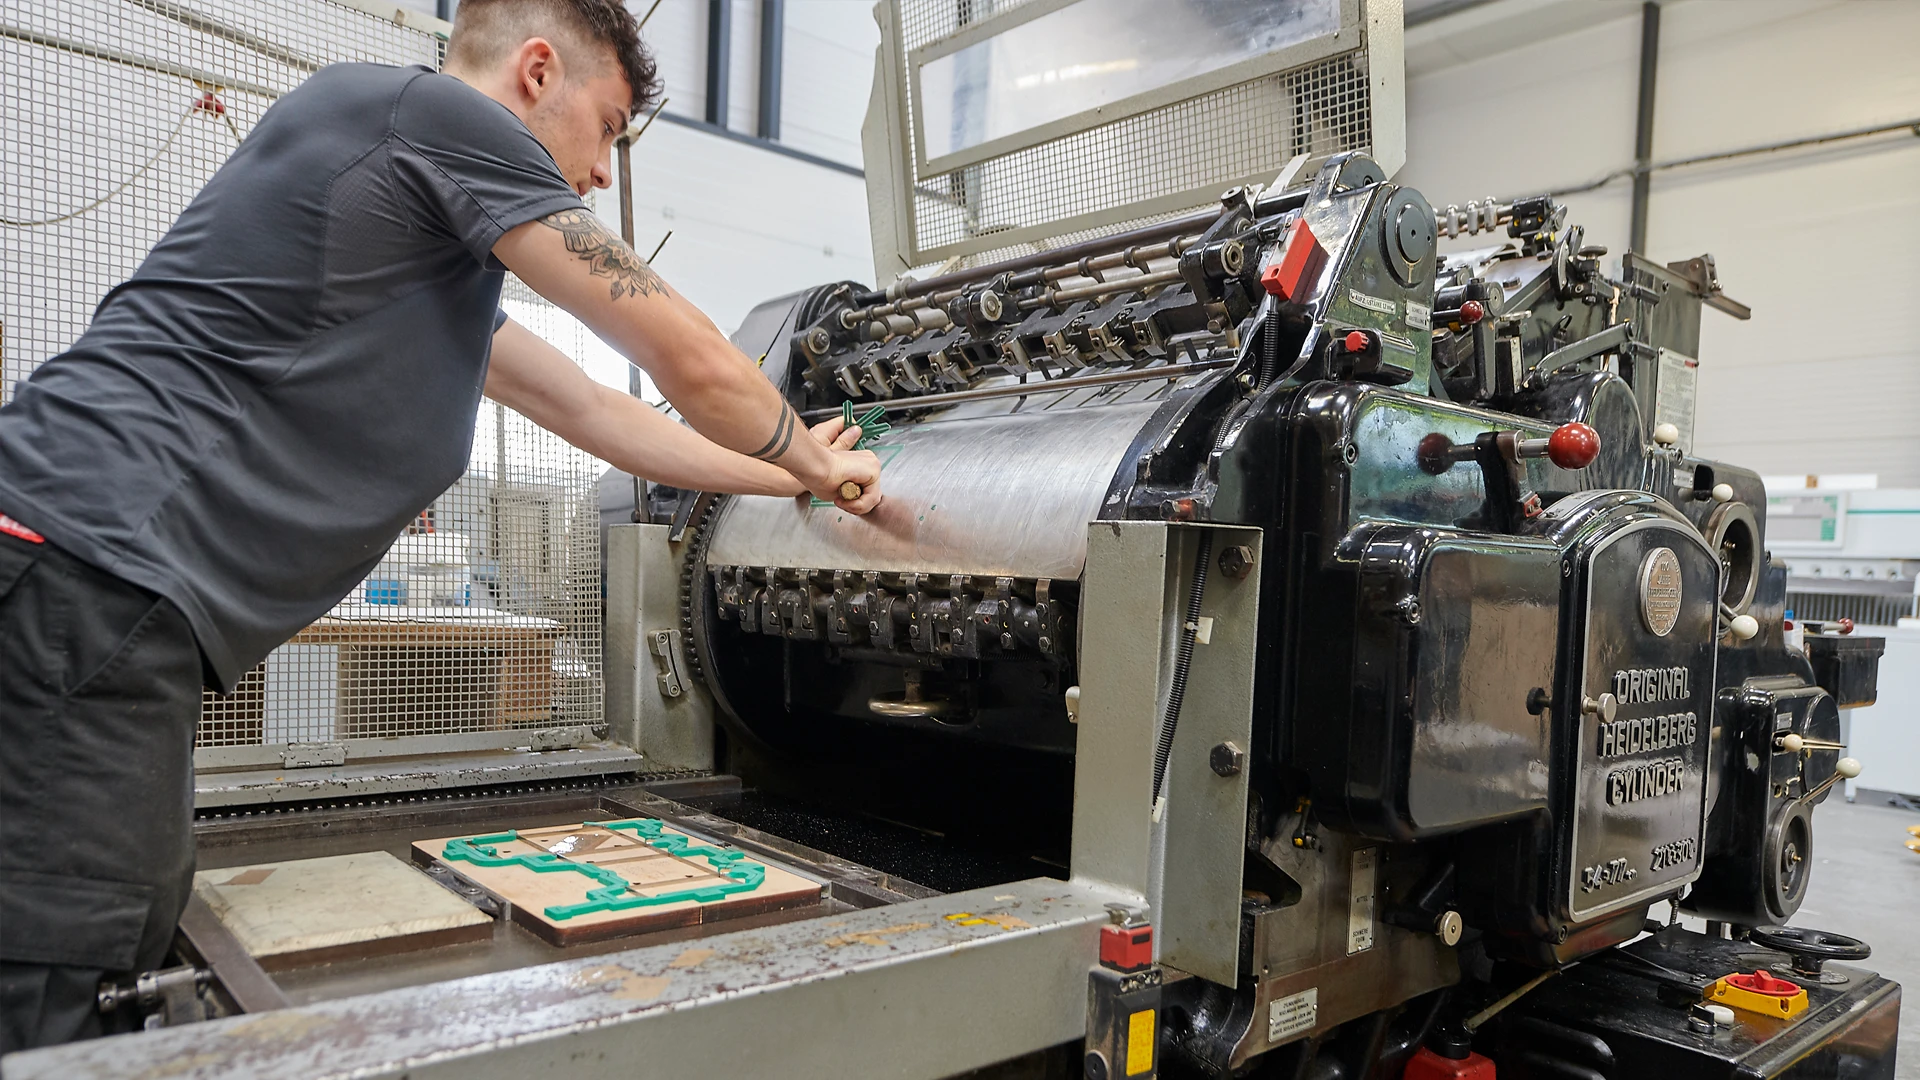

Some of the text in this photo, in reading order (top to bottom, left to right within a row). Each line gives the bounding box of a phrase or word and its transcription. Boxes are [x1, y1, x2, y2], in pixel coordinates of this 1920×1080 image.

[1613, 667, 1690, 704] ORIGINAL
[1599, 712, 1697, 758] HEIDELBERG
[1607, 758, 1685, 805] CYLINDER
